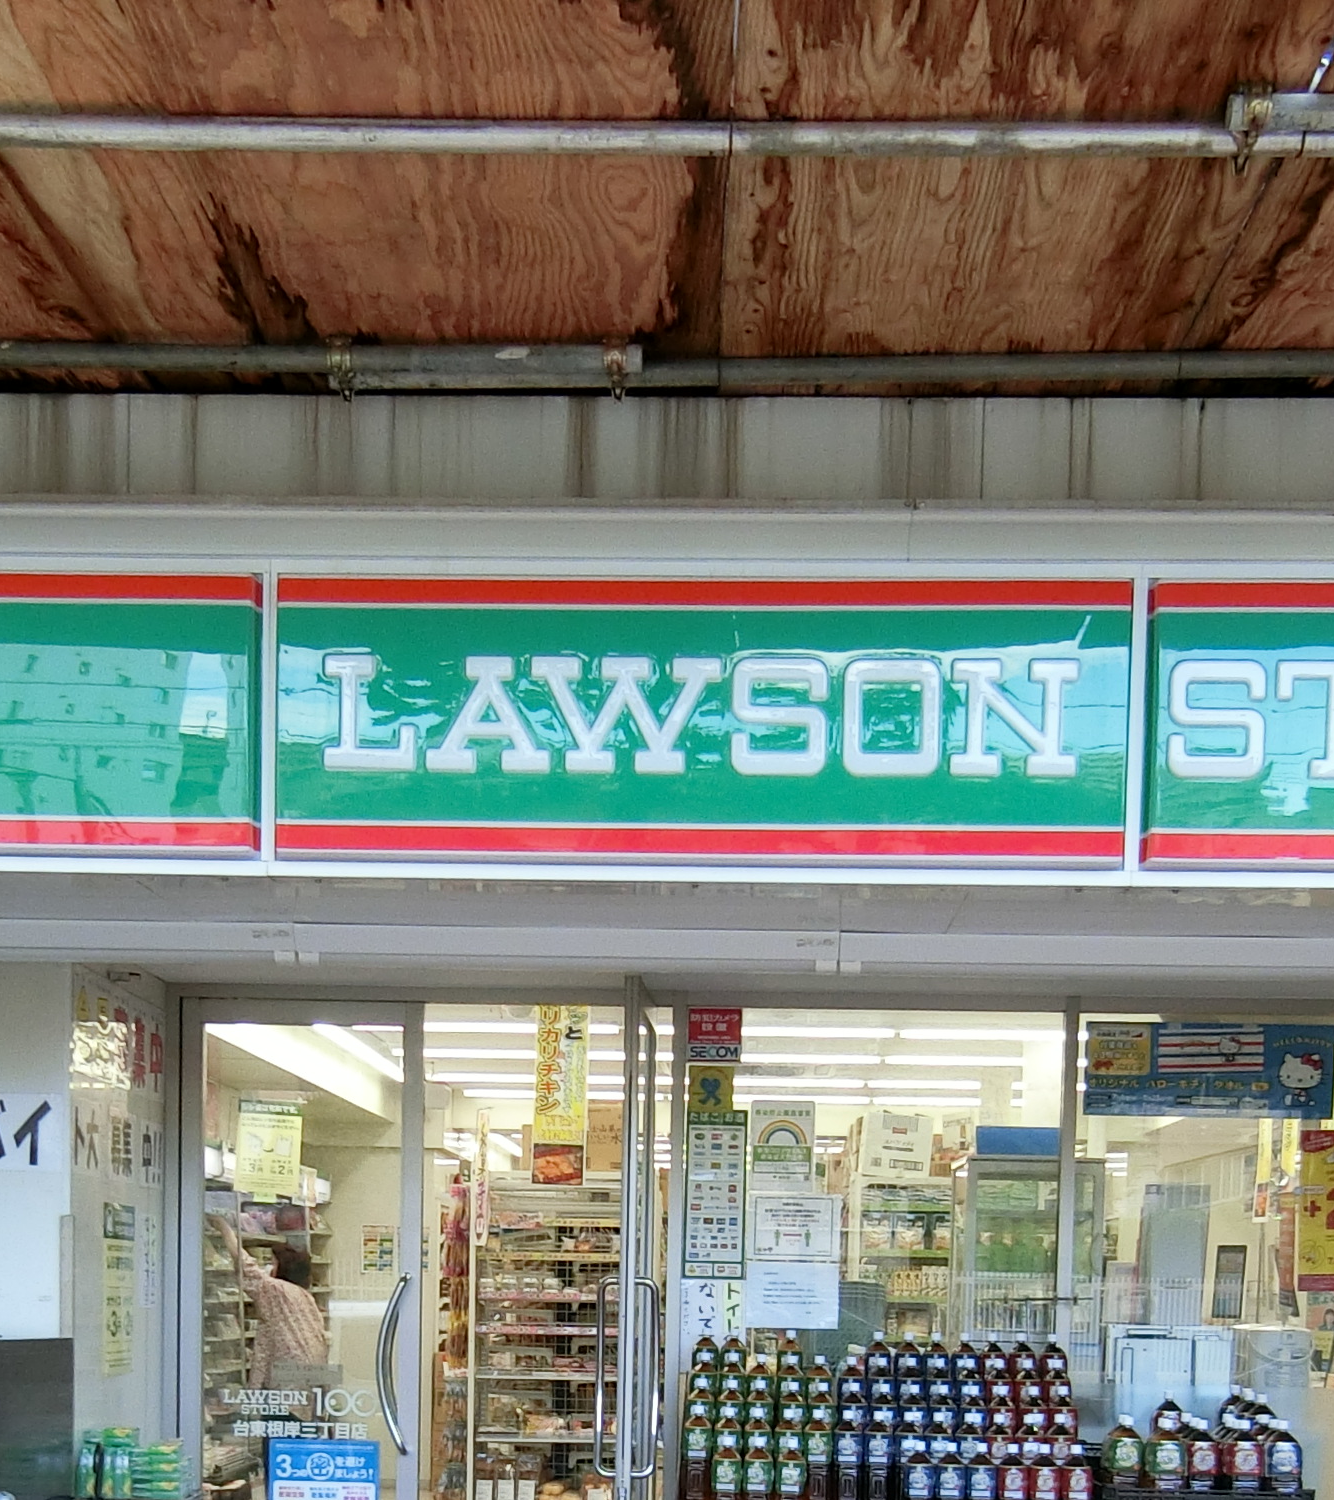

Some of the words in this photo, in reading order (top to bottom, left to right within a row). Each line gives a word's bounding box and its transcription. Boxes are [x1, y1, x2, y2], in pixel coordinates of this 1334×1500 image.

[322, 652, 1082, 778] LAWSON
[689, 1045, 739, 1059] SECOM
[222, 1388, 309, 1406] LAWSON
[312, 1387, 379, 1417] 100
[241, 1404, 290, 1416] STORE
[232, 1419, 369, 1440] 台東根岸三丁目店
